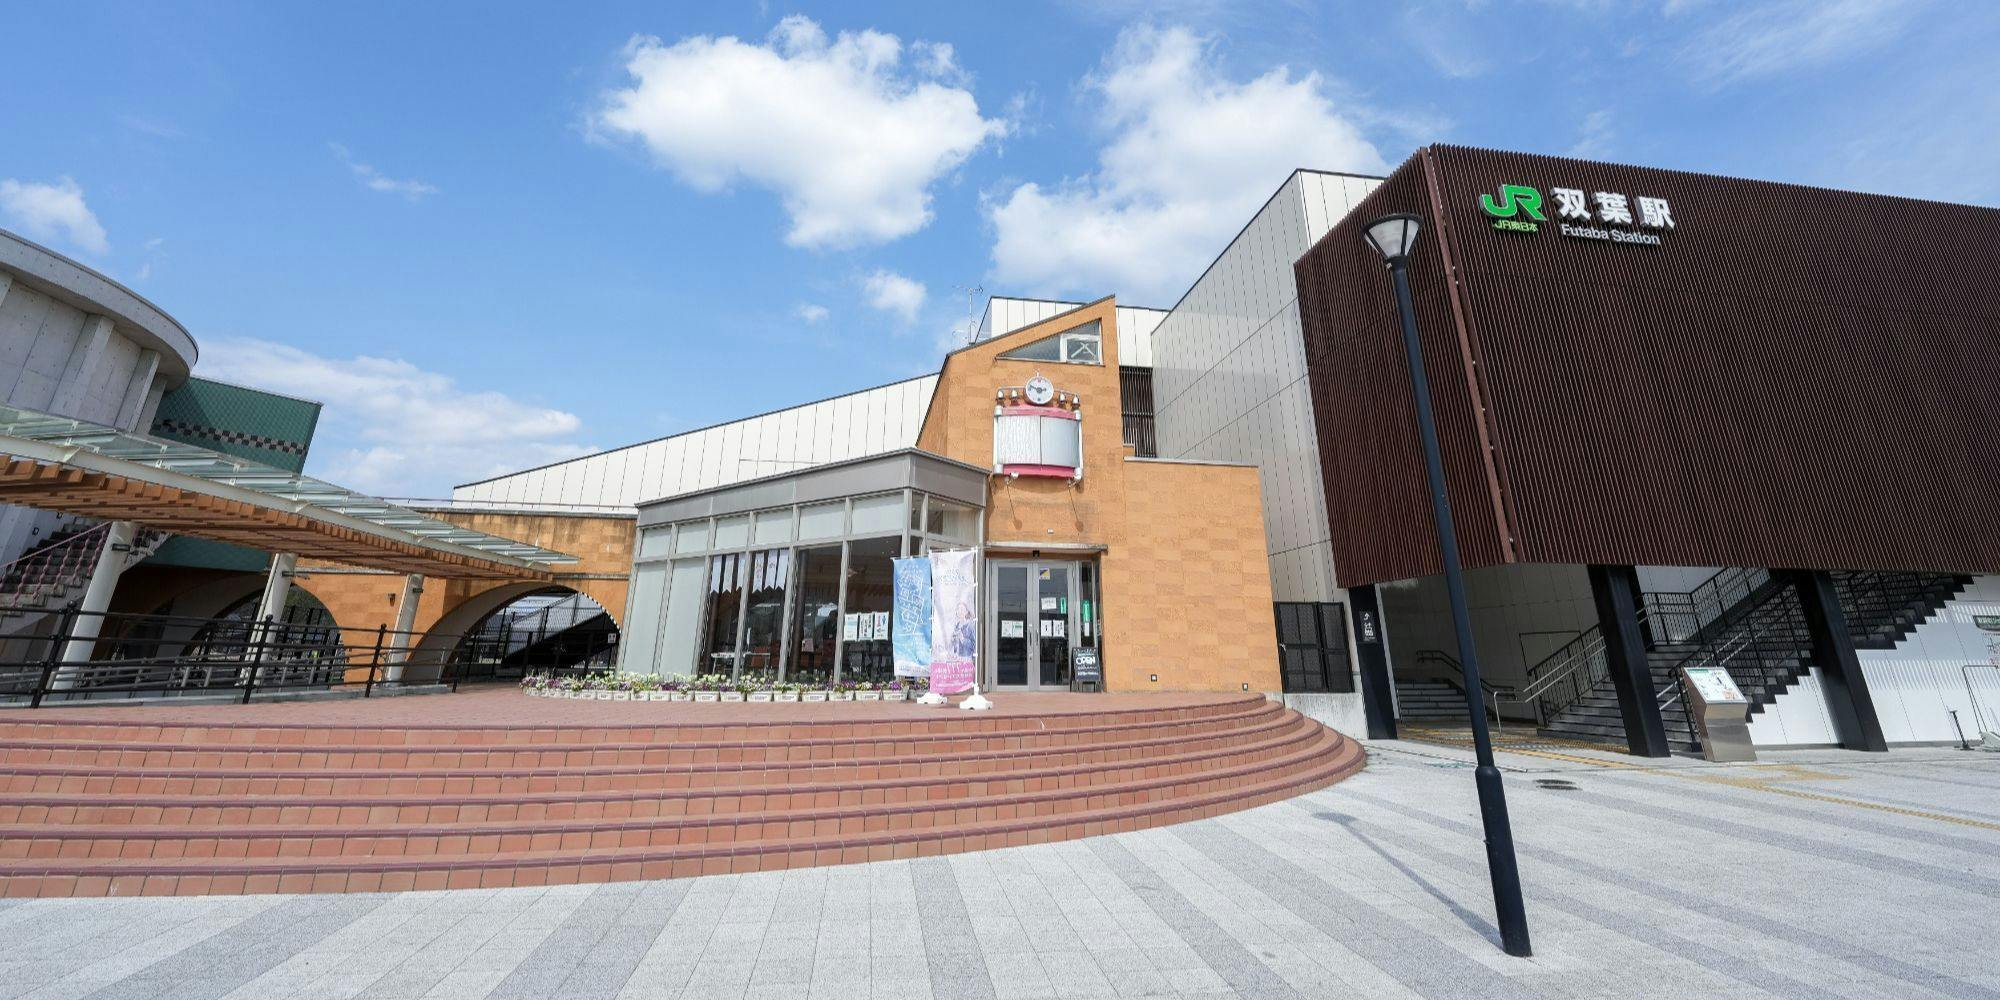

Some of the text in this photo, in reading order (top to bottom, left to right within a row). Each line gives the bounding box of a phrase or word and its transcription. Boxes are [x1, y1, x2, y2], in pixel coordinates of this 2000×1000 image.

[1480, 184, 1547, 221] JR
[1552, 187, 1675, 231] 双葉駅
[1495, 219, 1538, 232] JR東日本
[1561, 223, 1661, 245] Futaba Station
[1075, 656, 1096, 665] OPEN
